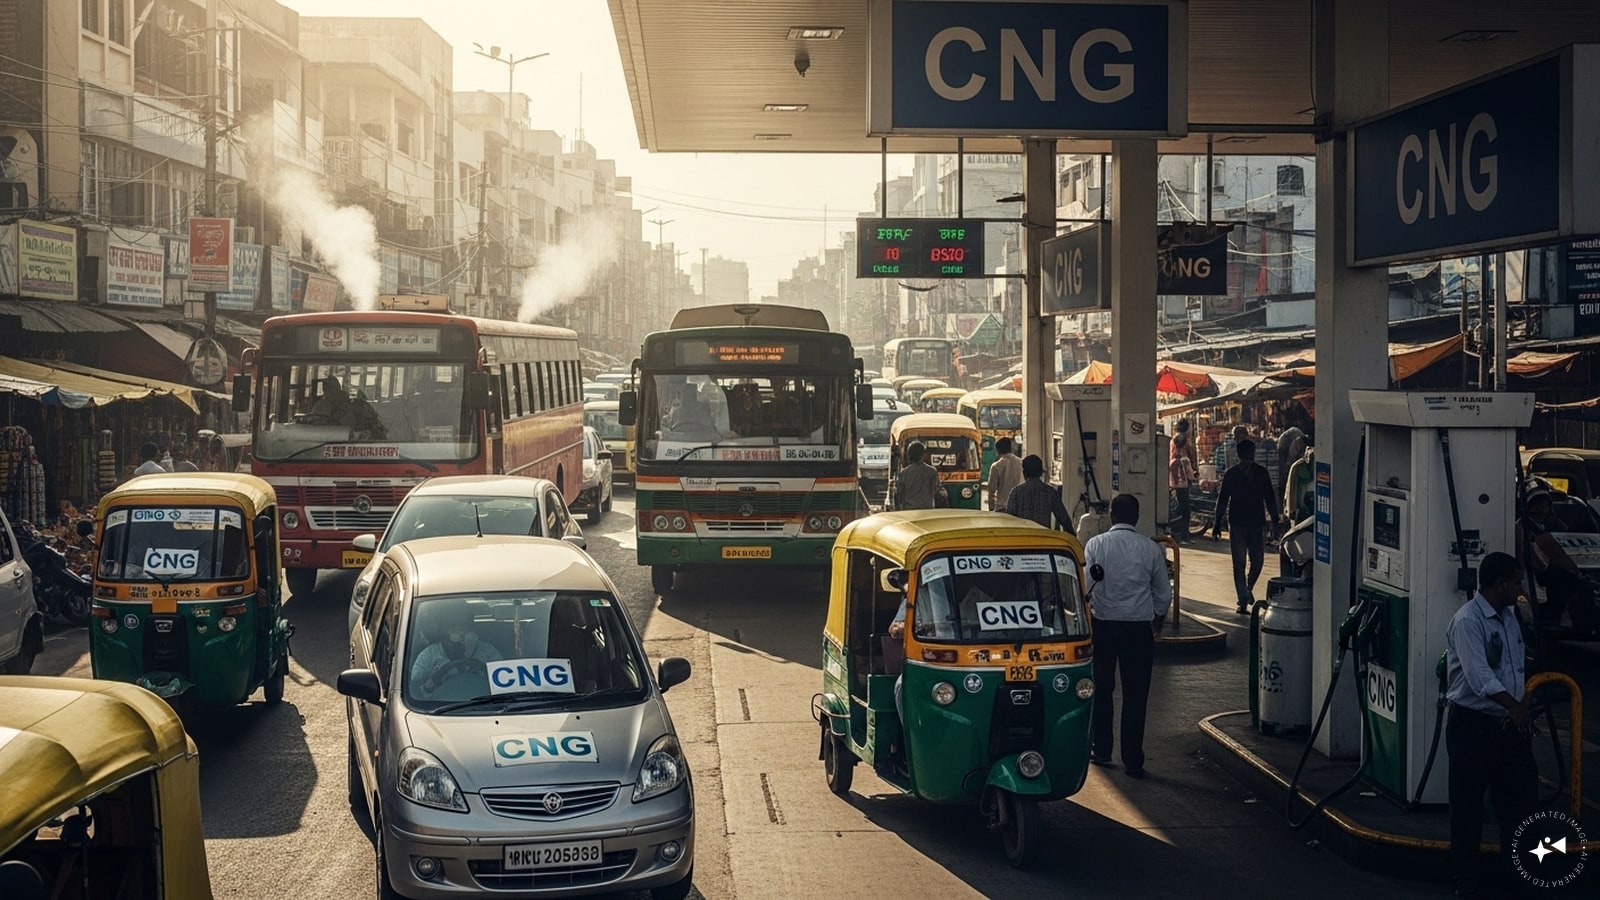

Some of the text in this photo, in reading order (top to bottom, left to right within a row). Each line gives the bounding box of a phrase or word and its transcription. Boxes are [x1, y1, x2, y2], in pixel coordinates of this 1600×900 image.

[925, 26, 1135, 103] CNG
[1396, 112, 1499, 225] CNG
[1055, 247, 1083, 298] CNG
[147, 552, 195, 569] CNG
[981, 605, 1038, 626] CNG
[491, 664, 569, 688] CNG
[1368, 671, 1395, 712] CNG
[496, 736, 592, 760] CNG
